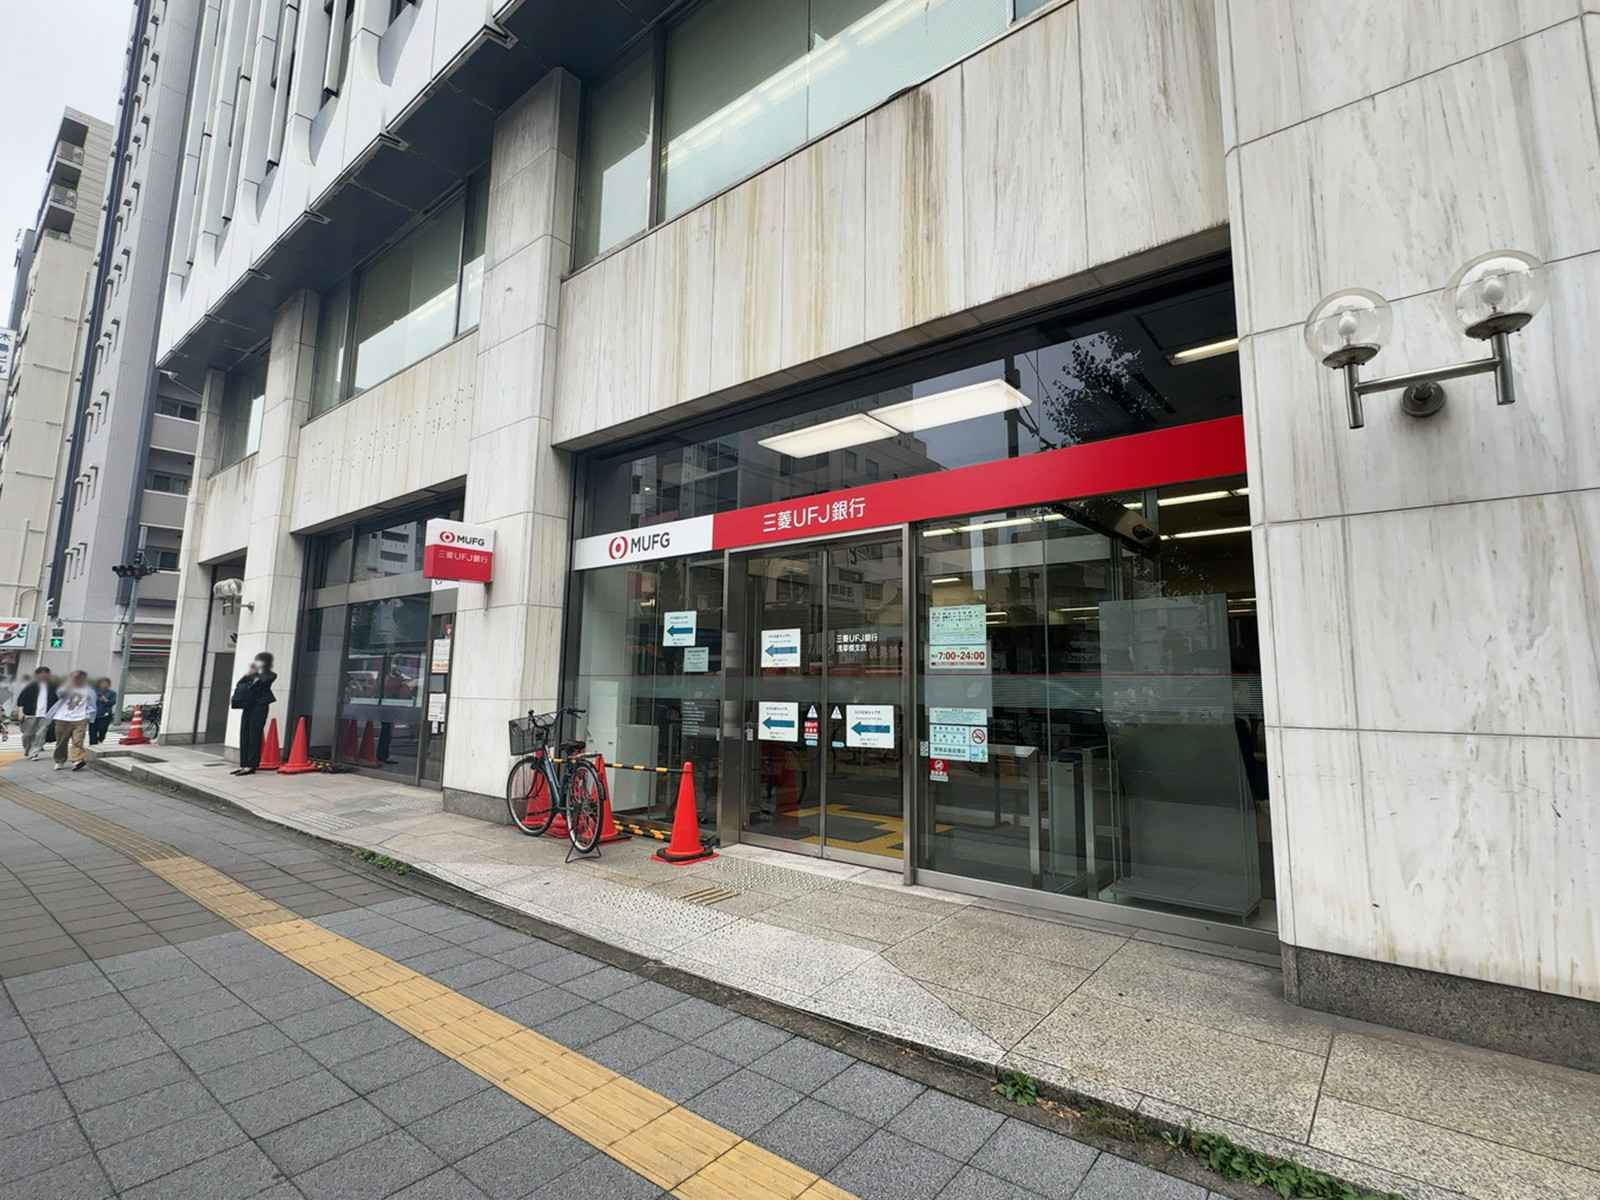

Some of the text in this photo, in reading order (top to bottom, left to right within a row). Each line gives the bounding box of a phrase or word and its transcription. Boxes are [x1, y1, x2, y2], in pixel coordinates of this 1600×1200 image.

[763, 497, 866, 532] 三菱UFJ銀行
[457, 535, 485, 546] MUFG
[630, 532, 670, 553] MUFG
[438, 549, 488, 564] 三菱UFJ銀行
[836, 632, 878, 643] 三菱UFJ銀行
